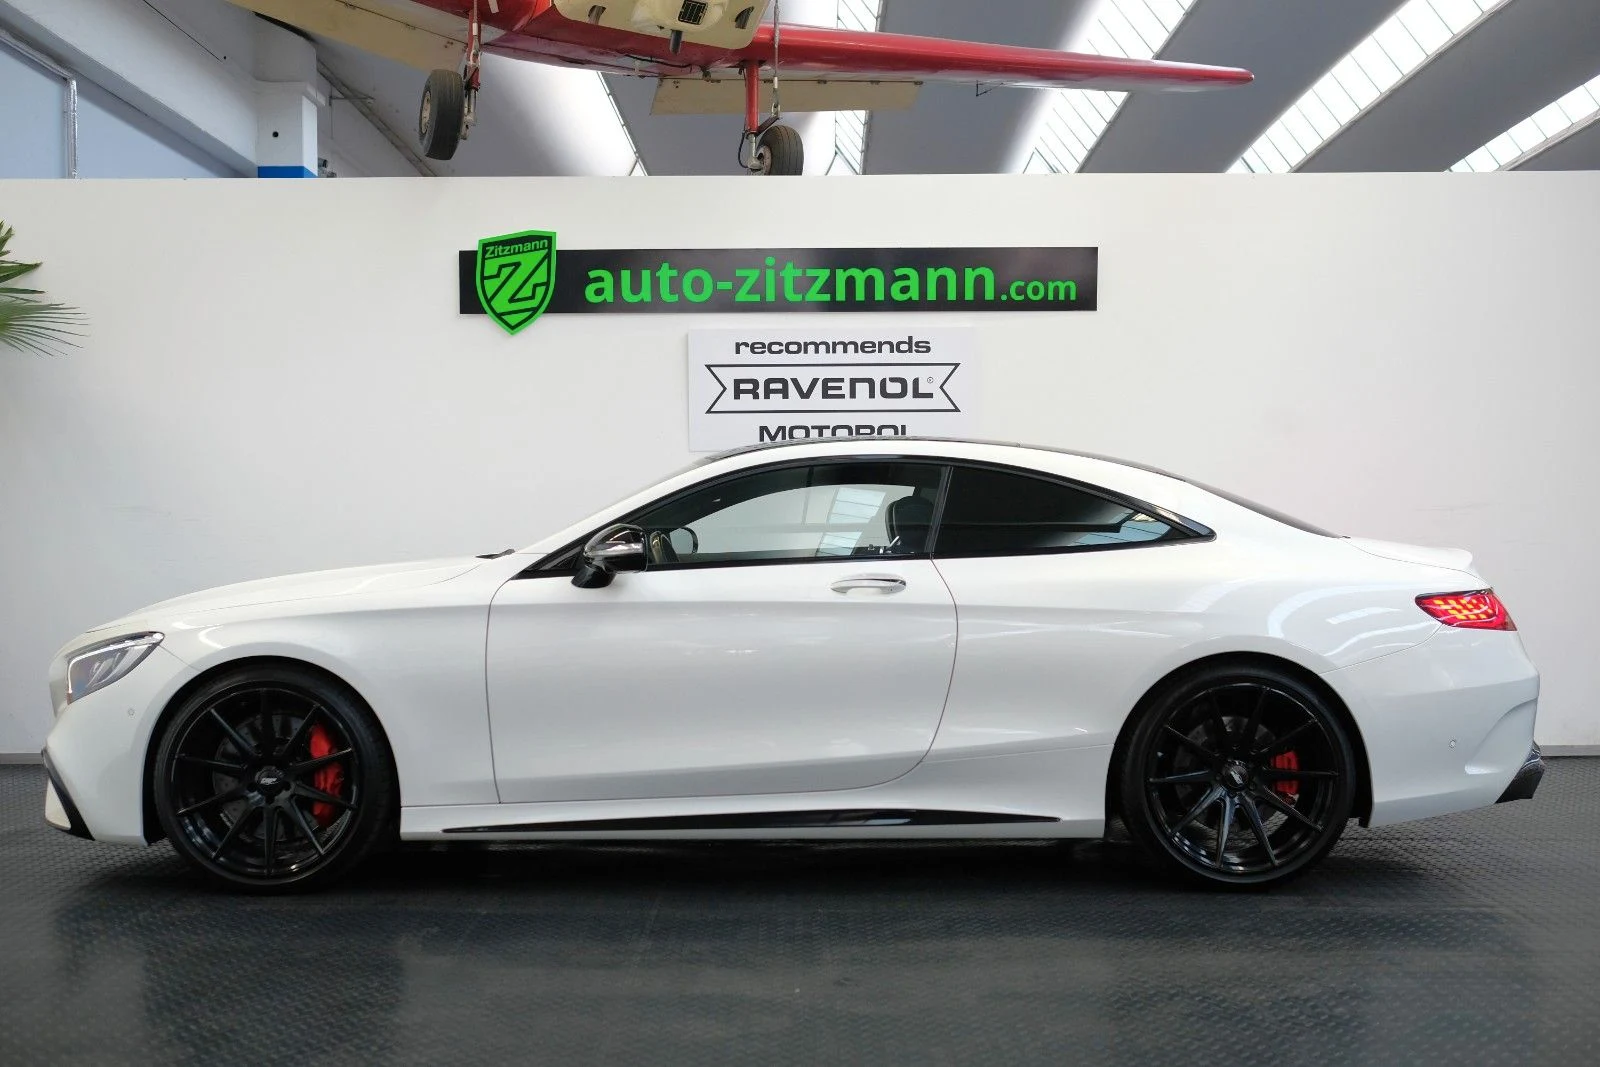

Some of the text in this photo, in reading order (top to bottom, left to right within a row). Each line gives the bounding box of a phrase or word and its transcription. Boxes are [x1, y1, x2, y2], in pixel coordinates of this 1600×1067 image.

[485, 240, 549, 259] Zitzmann
[584, 256, 1077, 304] auto-zitzmann.com
[735, 336, 932, 355] recommends
[733, 377, 934, 400] RAVENOL
